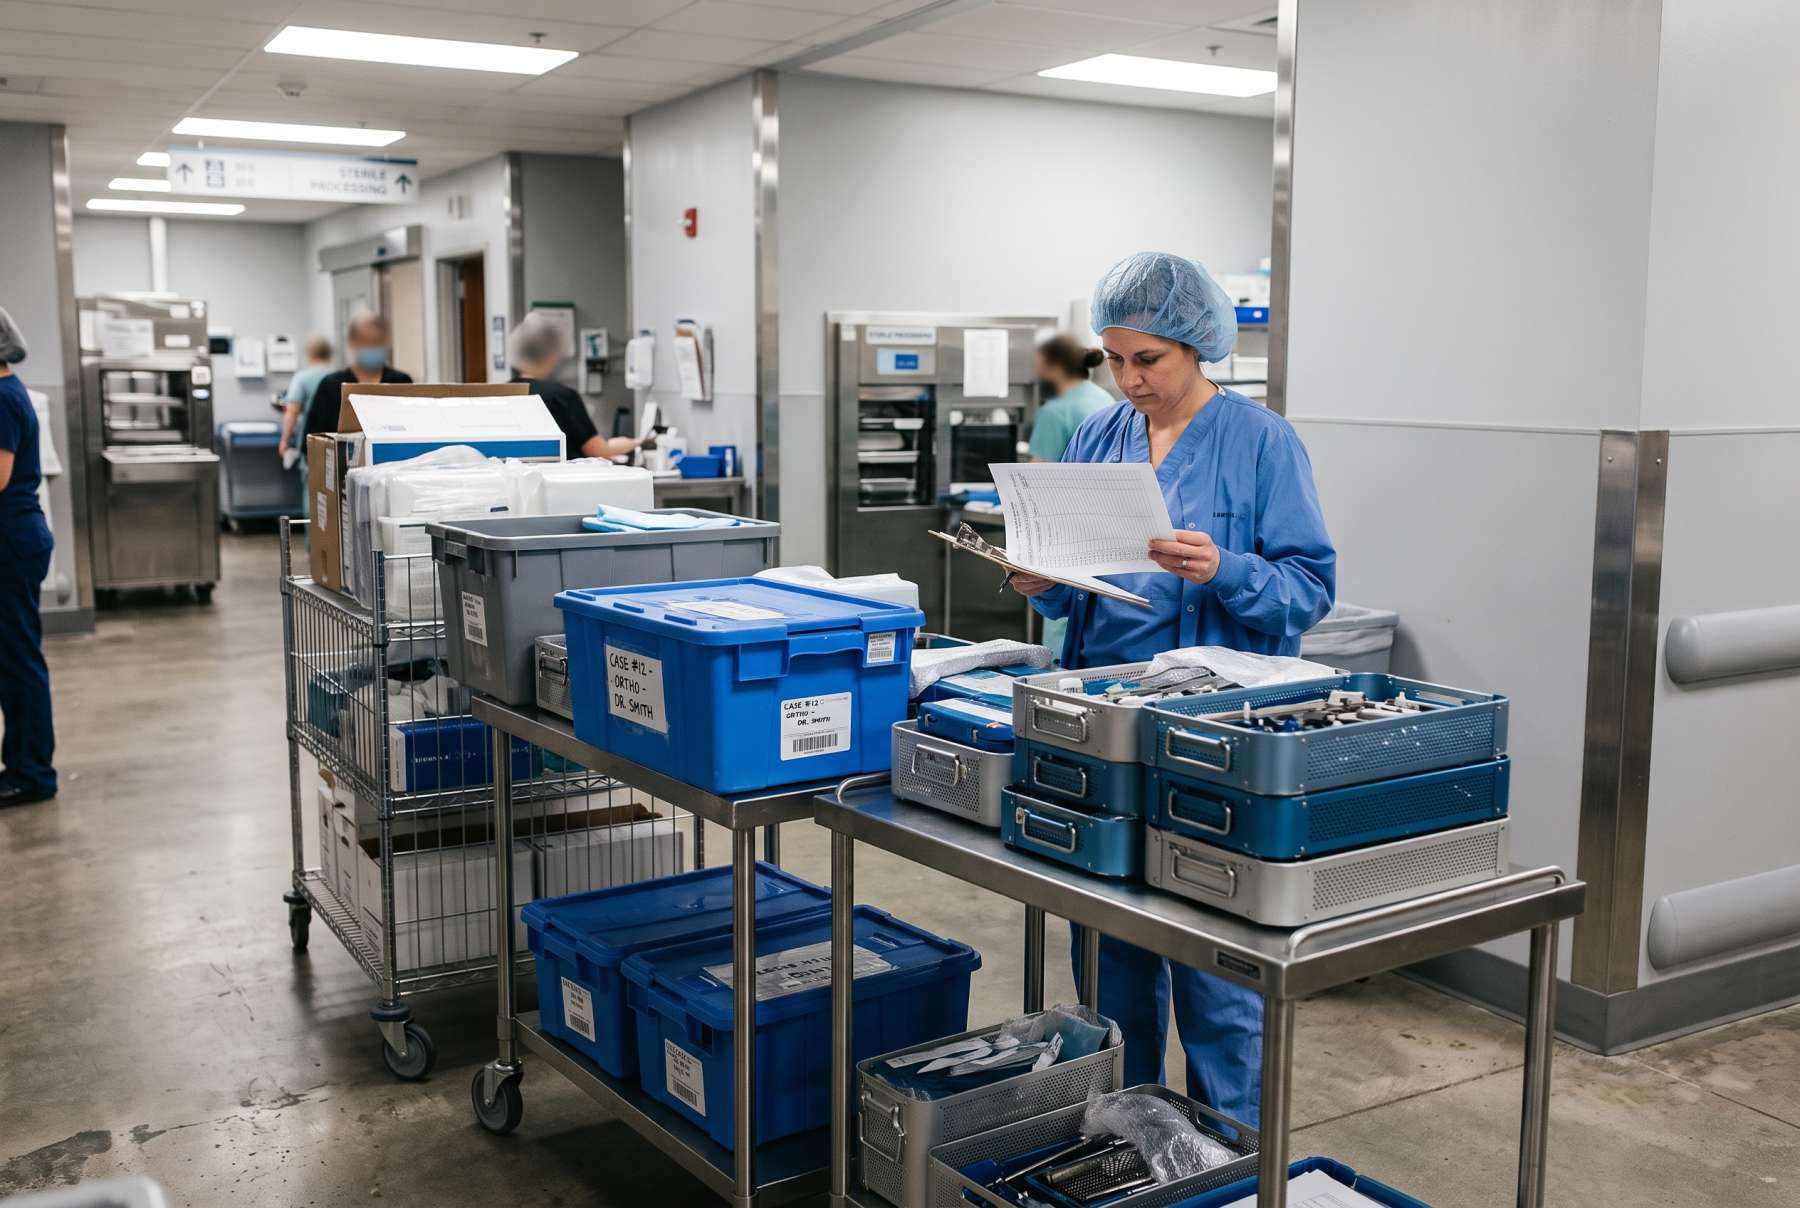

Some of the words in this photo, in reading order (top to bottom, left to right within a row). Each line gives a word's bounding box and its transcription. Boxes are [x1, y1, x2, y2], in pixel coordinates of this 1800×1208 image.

[610, 653, 629, 671] CASE
[631, 659, 647, 676] #12
[615, 675, 640, 694] ORTHO
[614, 694, 626, 709] DR.
[629, 698, 654, 720] SMITH
[784, 702, 802, 710] CASE
